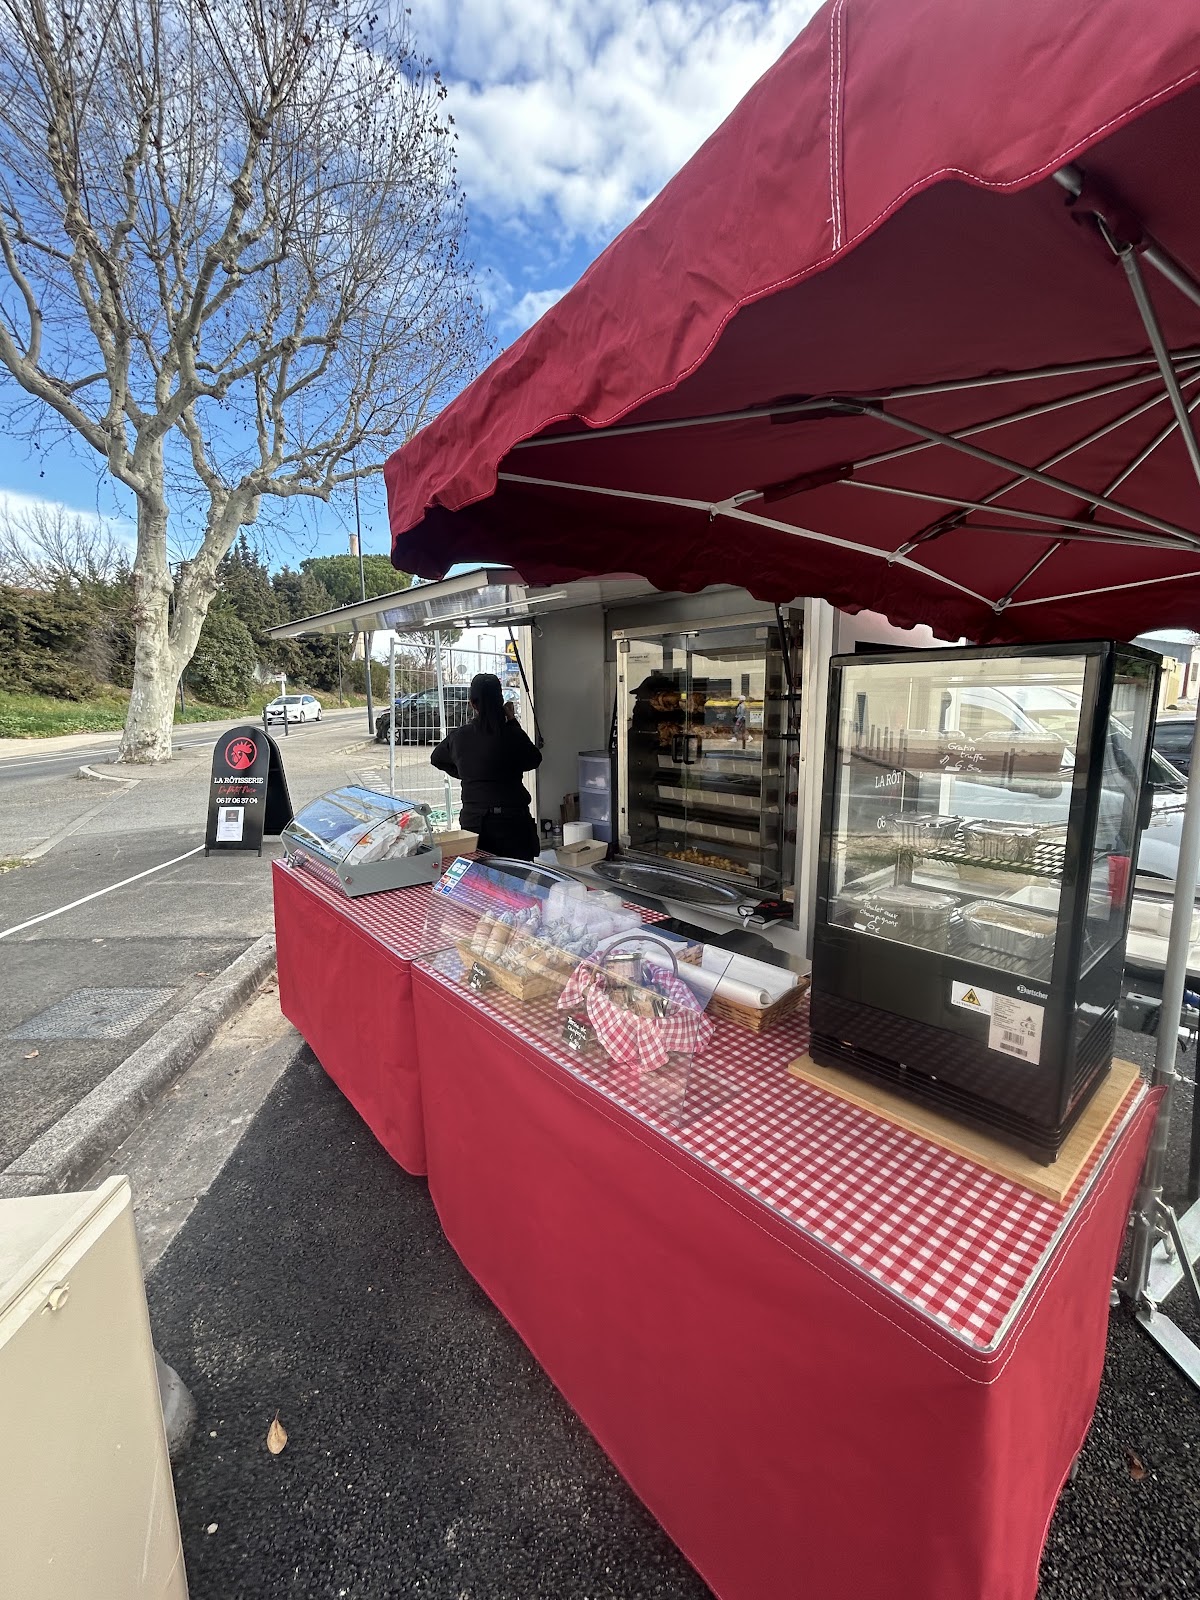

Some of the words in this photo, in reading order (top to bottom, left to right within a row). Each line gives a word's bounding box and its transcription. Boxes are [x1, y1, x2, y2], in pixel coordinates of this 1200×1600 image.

[947, 742, 976, 752] Gratin
[960, 751, 987, 763] truffe
[224, 776, 264, 784] RÔTISSERIE
[875, 775, 886, 789] LA
